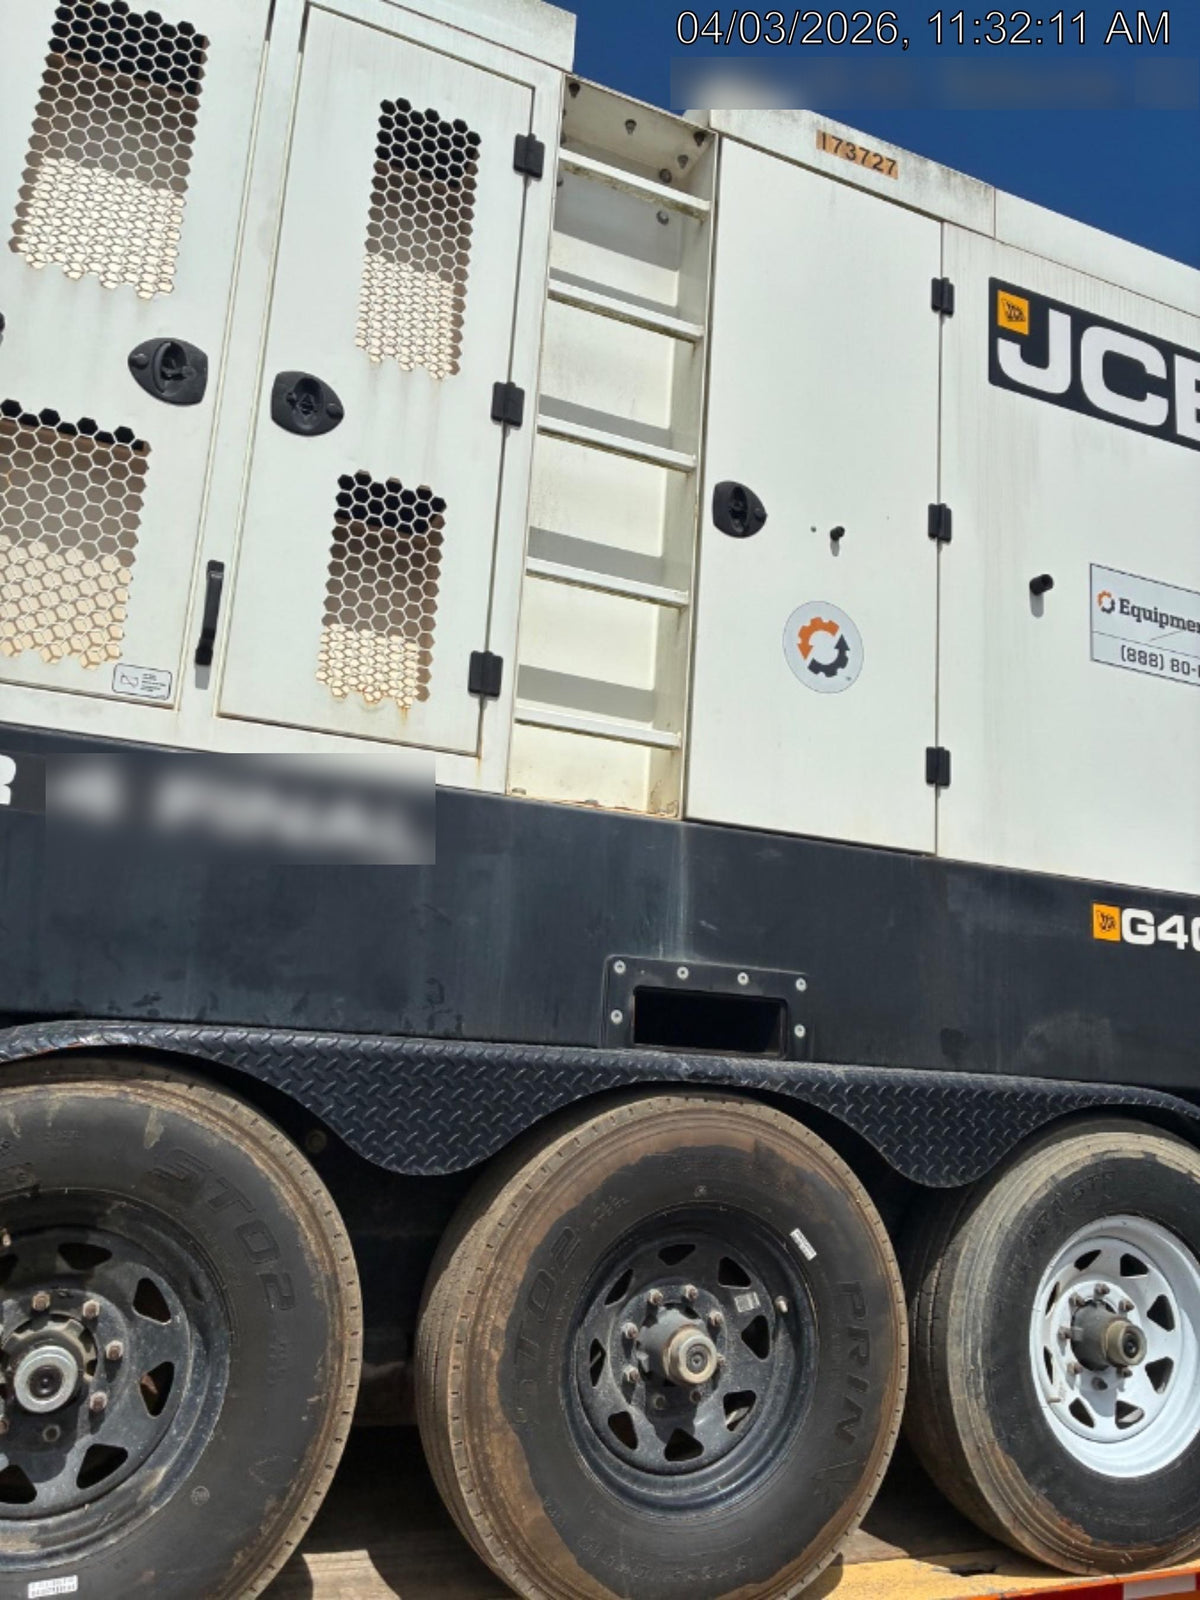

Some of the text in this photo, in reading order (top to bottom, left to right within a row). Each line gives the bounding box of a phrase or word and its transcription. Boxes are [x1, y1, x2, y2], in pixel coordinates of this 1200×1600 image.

[821, 131, 897, 175] 173727
[1120, 645, 1200, 679] (888) 80-
